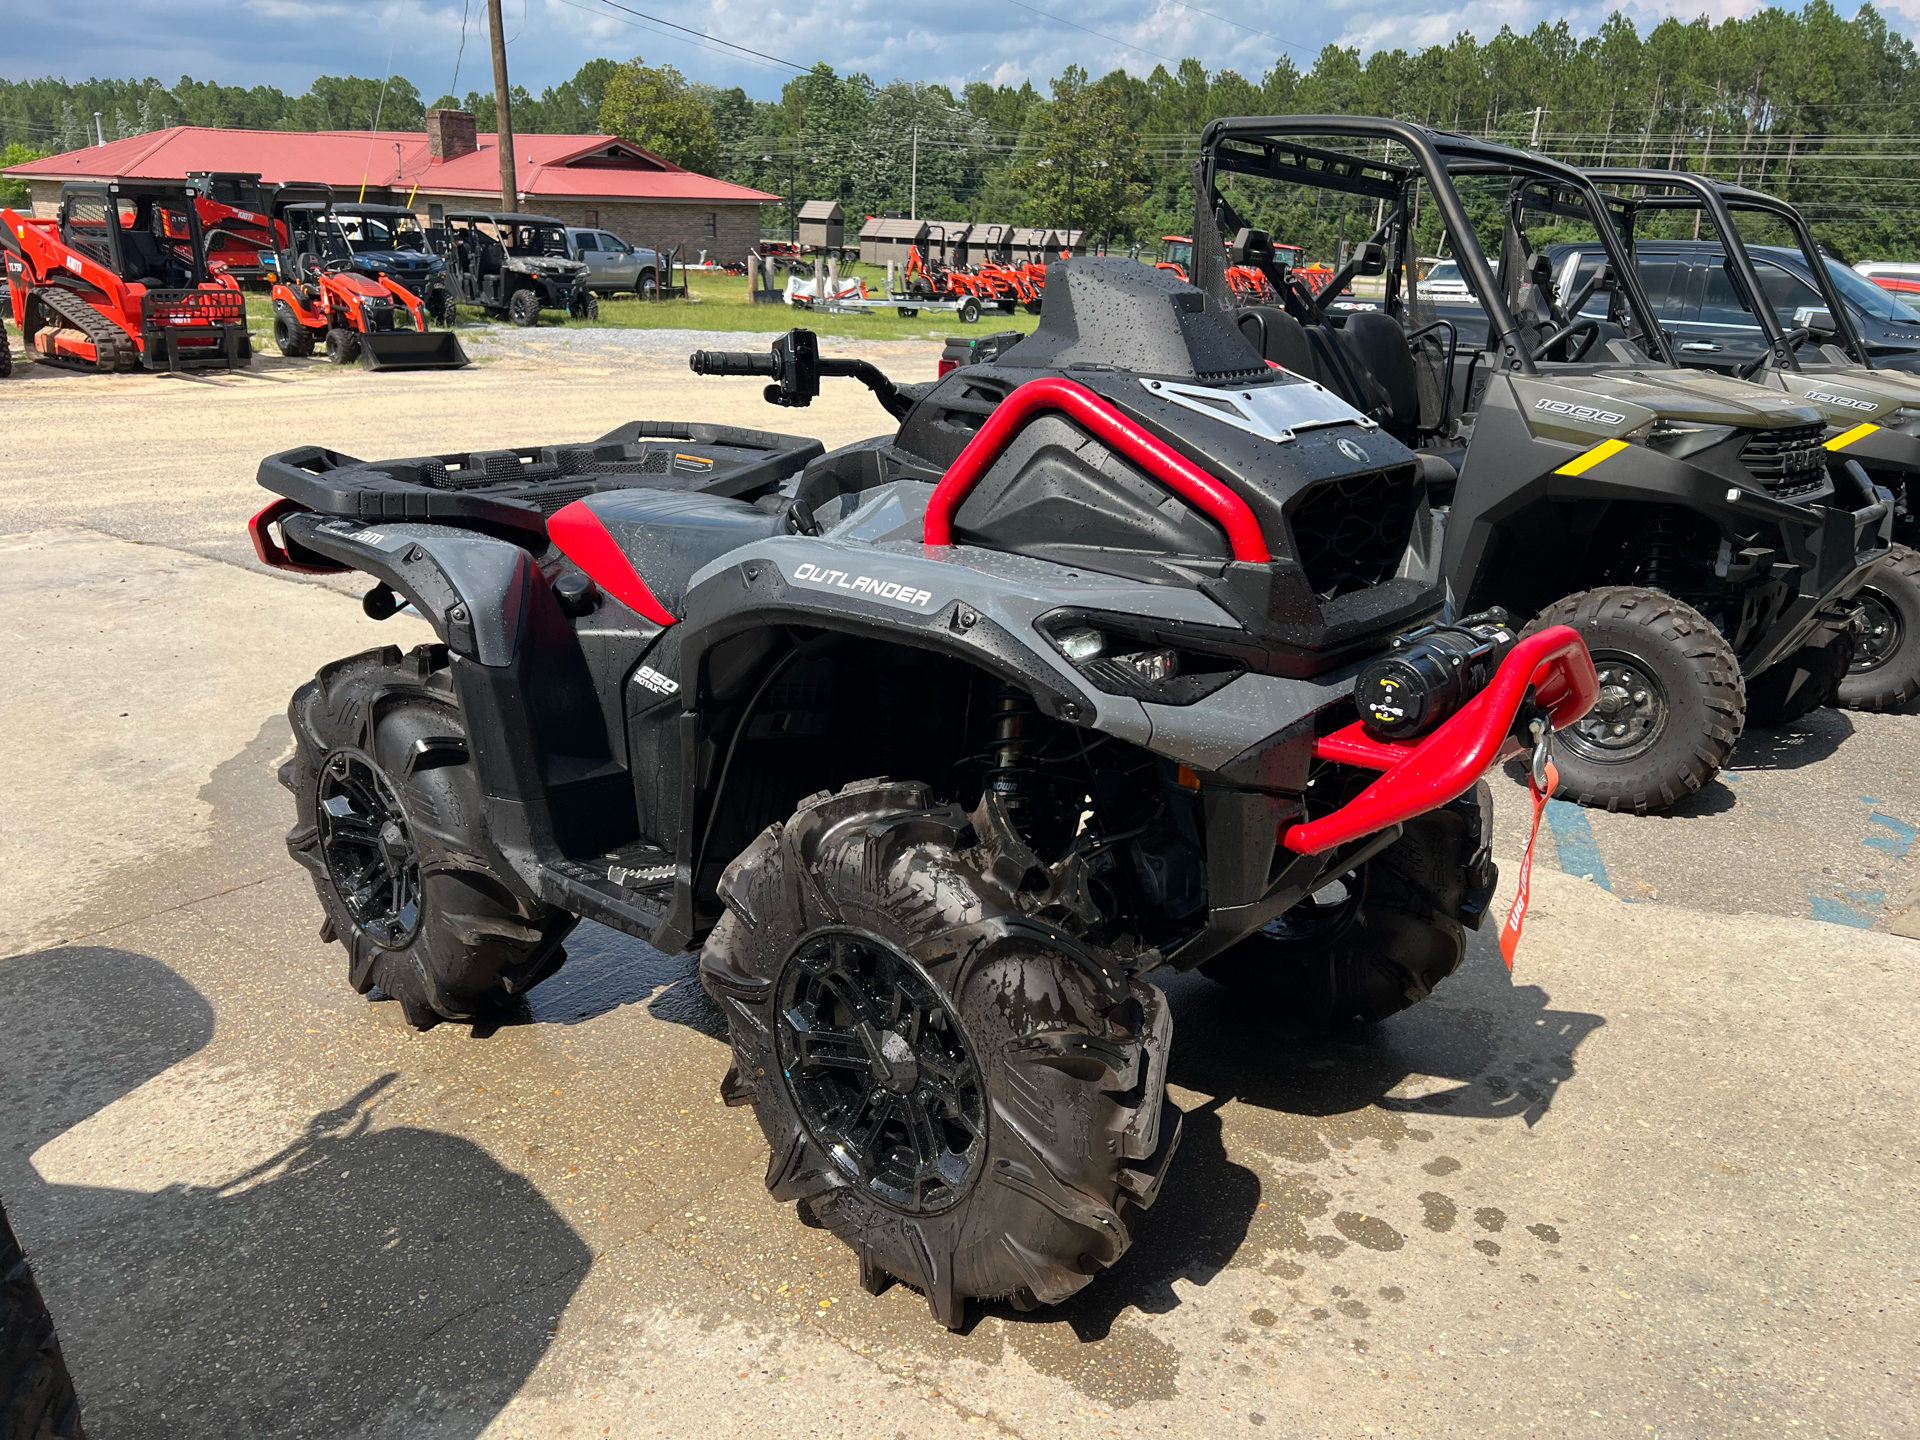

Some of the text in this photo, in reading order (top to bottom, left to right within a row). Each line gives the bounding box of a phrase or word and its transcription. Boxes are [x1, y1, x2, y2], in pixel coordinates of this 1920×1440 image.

[66, 254, 82, 275] KIOTI
[1535, 398, 1625, 424] 1000
[1804, 391, 1878, 412] 1000
[793, 563, 932, 607] OUTLANDER
[634, 674, 658, 694] ROTAX
[637, 665, 679, 693] 850
